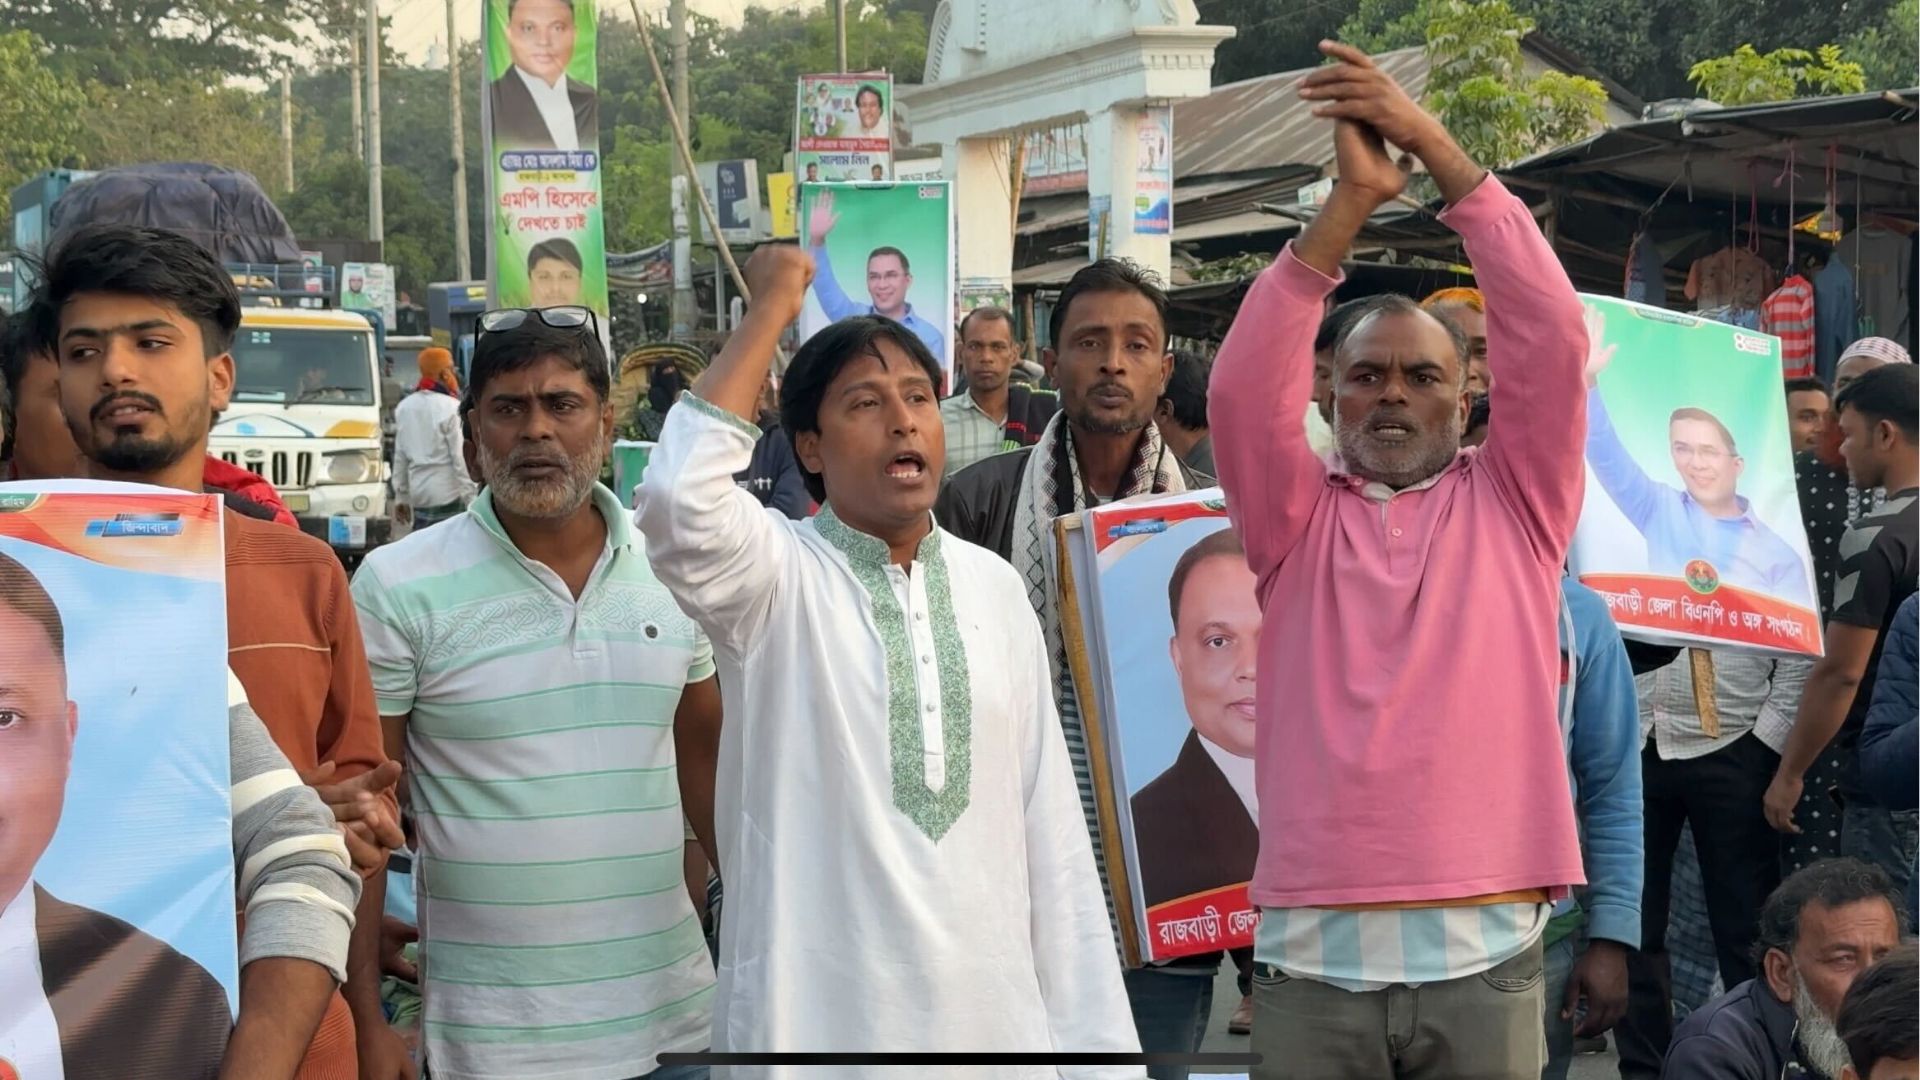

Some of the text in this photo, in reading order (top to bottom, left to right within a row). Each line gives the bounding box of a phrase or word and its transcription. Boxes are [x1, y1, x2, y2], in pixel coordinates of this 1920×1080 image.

[819, 152, 870, 166] সালাম নিন
[499, 186, 598, 209] এমপি হিসেবে
[518, 213, 587, 232] দেখতে চাই
[121, 519, 169, 533] জিন্দাবাদ
[1595, 588, 1643, 617] জবাড়ী
[1647, 597, 1676, 620] জেলা
[1681, 595, 1724, 627] বিএনপি
[1728, 612, 1738, 628] ও
[1742, 611, 1763, 632] অঙ্গ
[1766, 612, 1804, 639] সংগঠন
[1157, 905, 1223, 946] রাজবাড়ী
